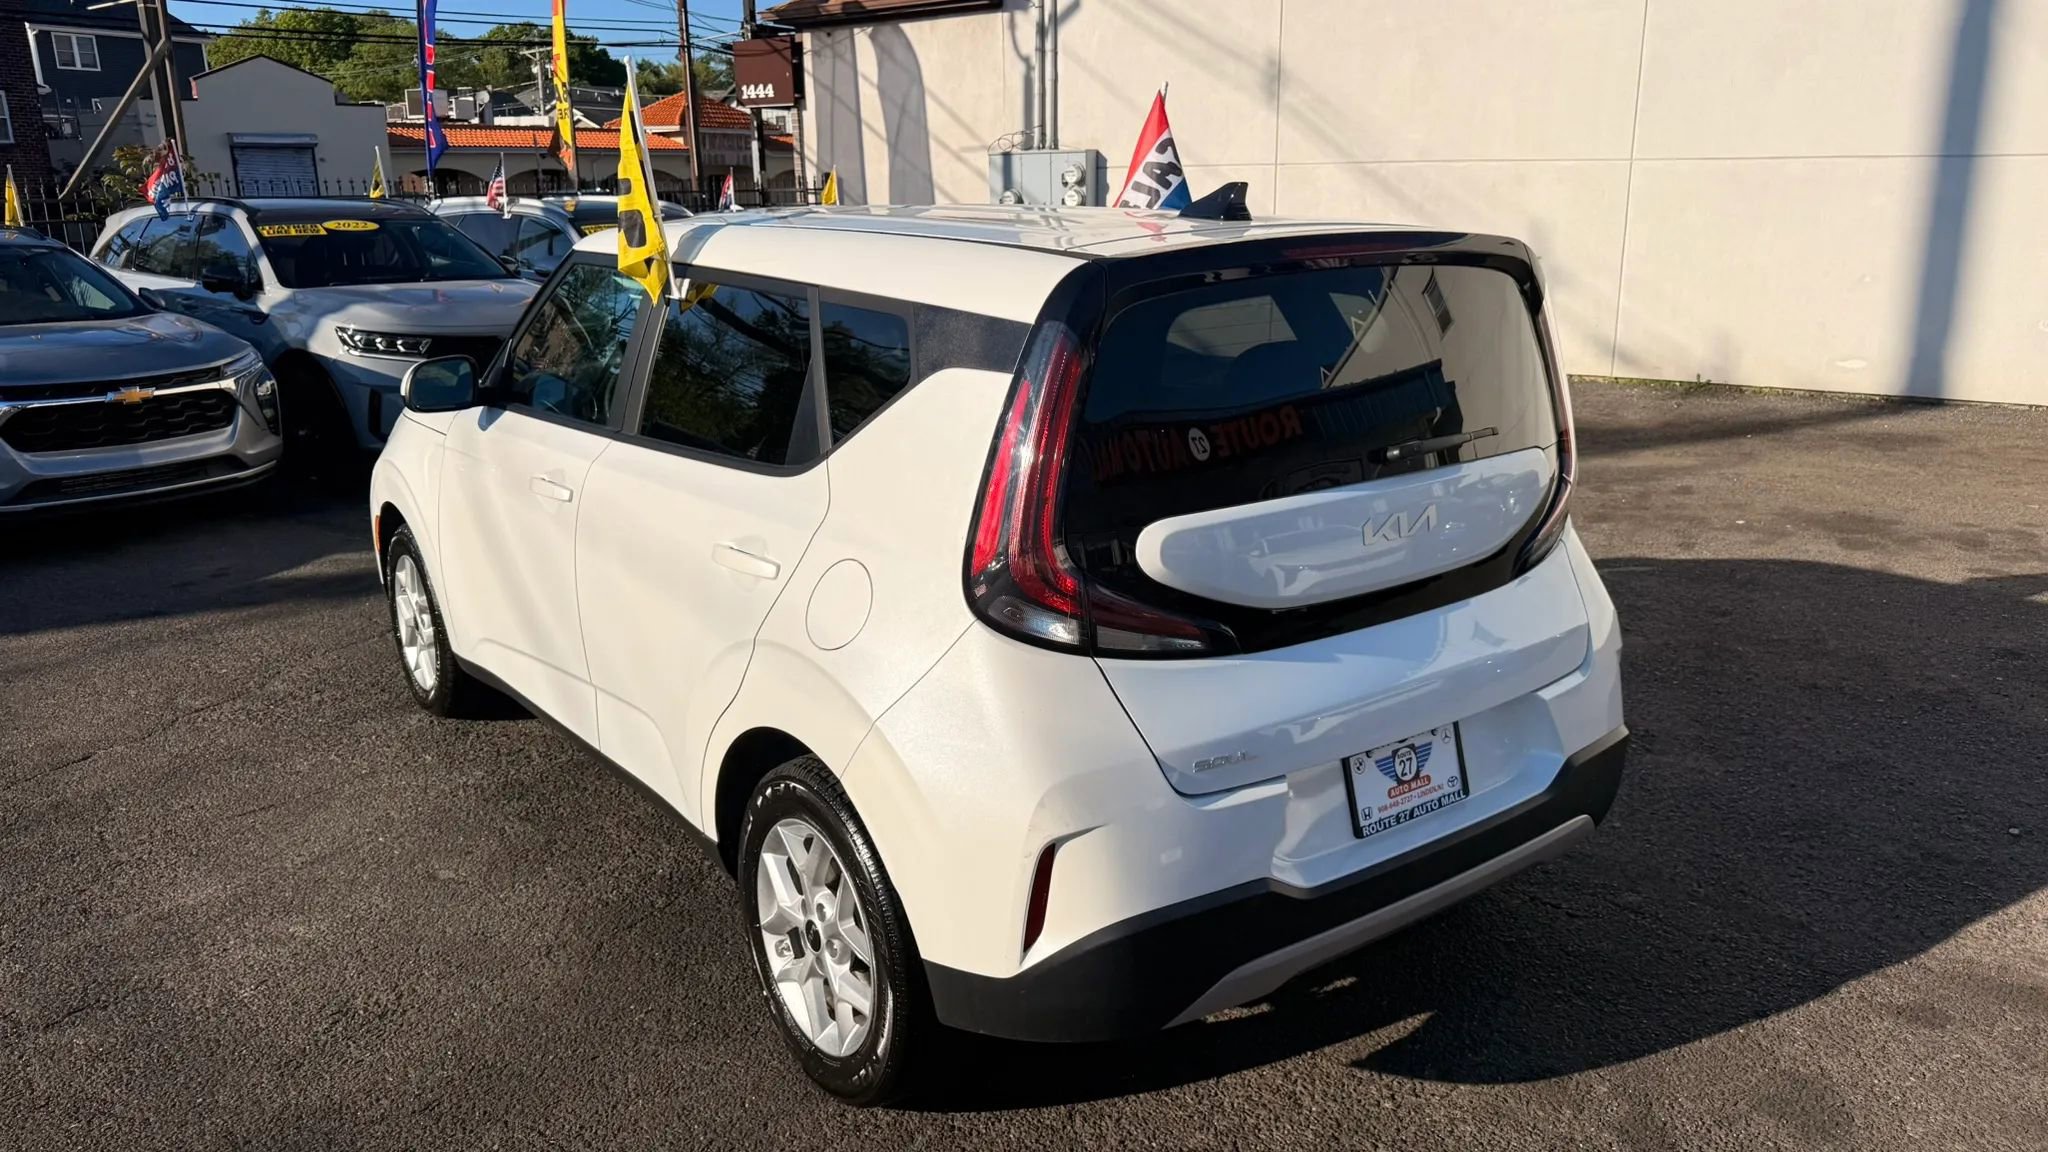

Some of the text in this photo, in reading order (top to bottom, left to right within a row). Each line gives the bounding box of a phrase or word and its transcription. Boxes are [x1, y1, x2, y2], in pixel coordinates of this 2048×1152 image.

[741, 83, 775, 99] 1444
[333, 221, 368, 229] 2022
[1361, 504, 1437, 546] KIA
[1398, 757, 1413, 778] 27
[1390, 776, 1430, 798] AUTO MALL
[1362, 790, 1467, 837] ROUTE 27 AUTO MALL
